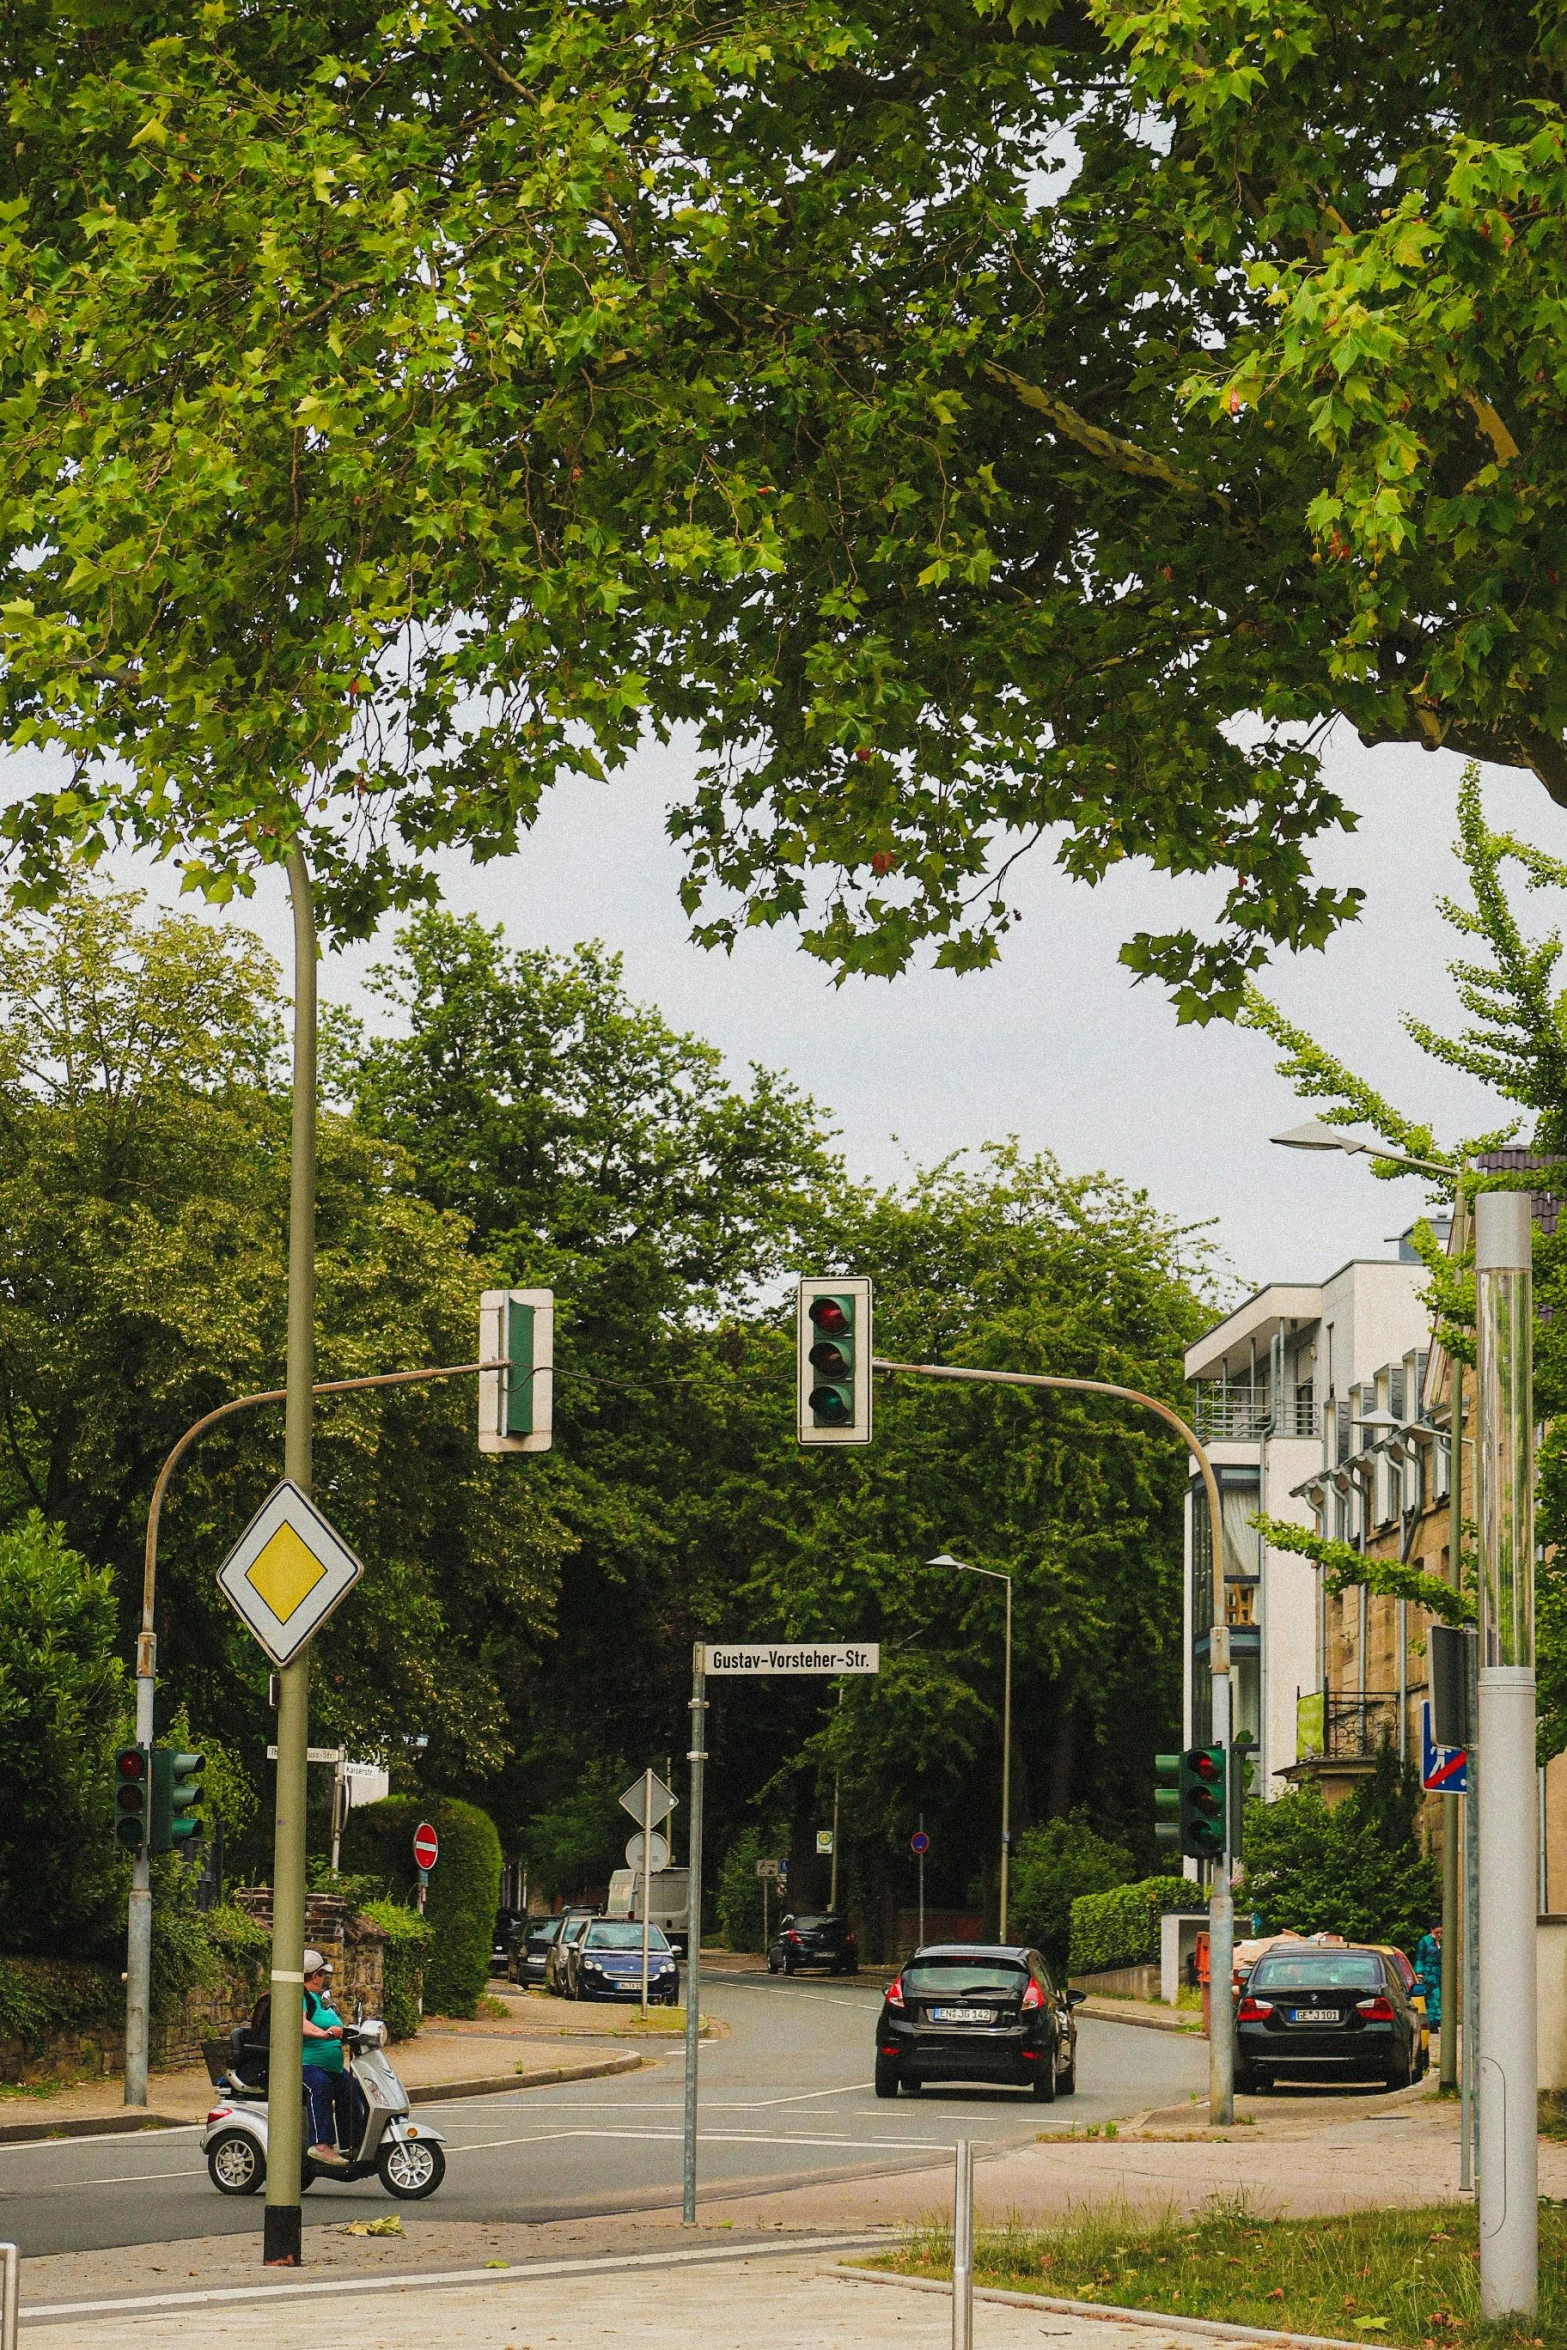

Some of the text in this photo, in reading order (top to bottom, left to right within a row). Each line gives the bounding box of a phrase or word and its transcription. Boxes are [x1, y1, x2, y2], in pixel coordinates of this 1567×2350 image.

[713, 1650, 869, 1668] Gustav-Vorsteher-Str.
[940, 2009, 952, 2018] EN
[972, 2010, 989, 2019] 142
[1297, 2011, 1308, 2019] GE
[1321, 2011, 1337, 2019] 101
